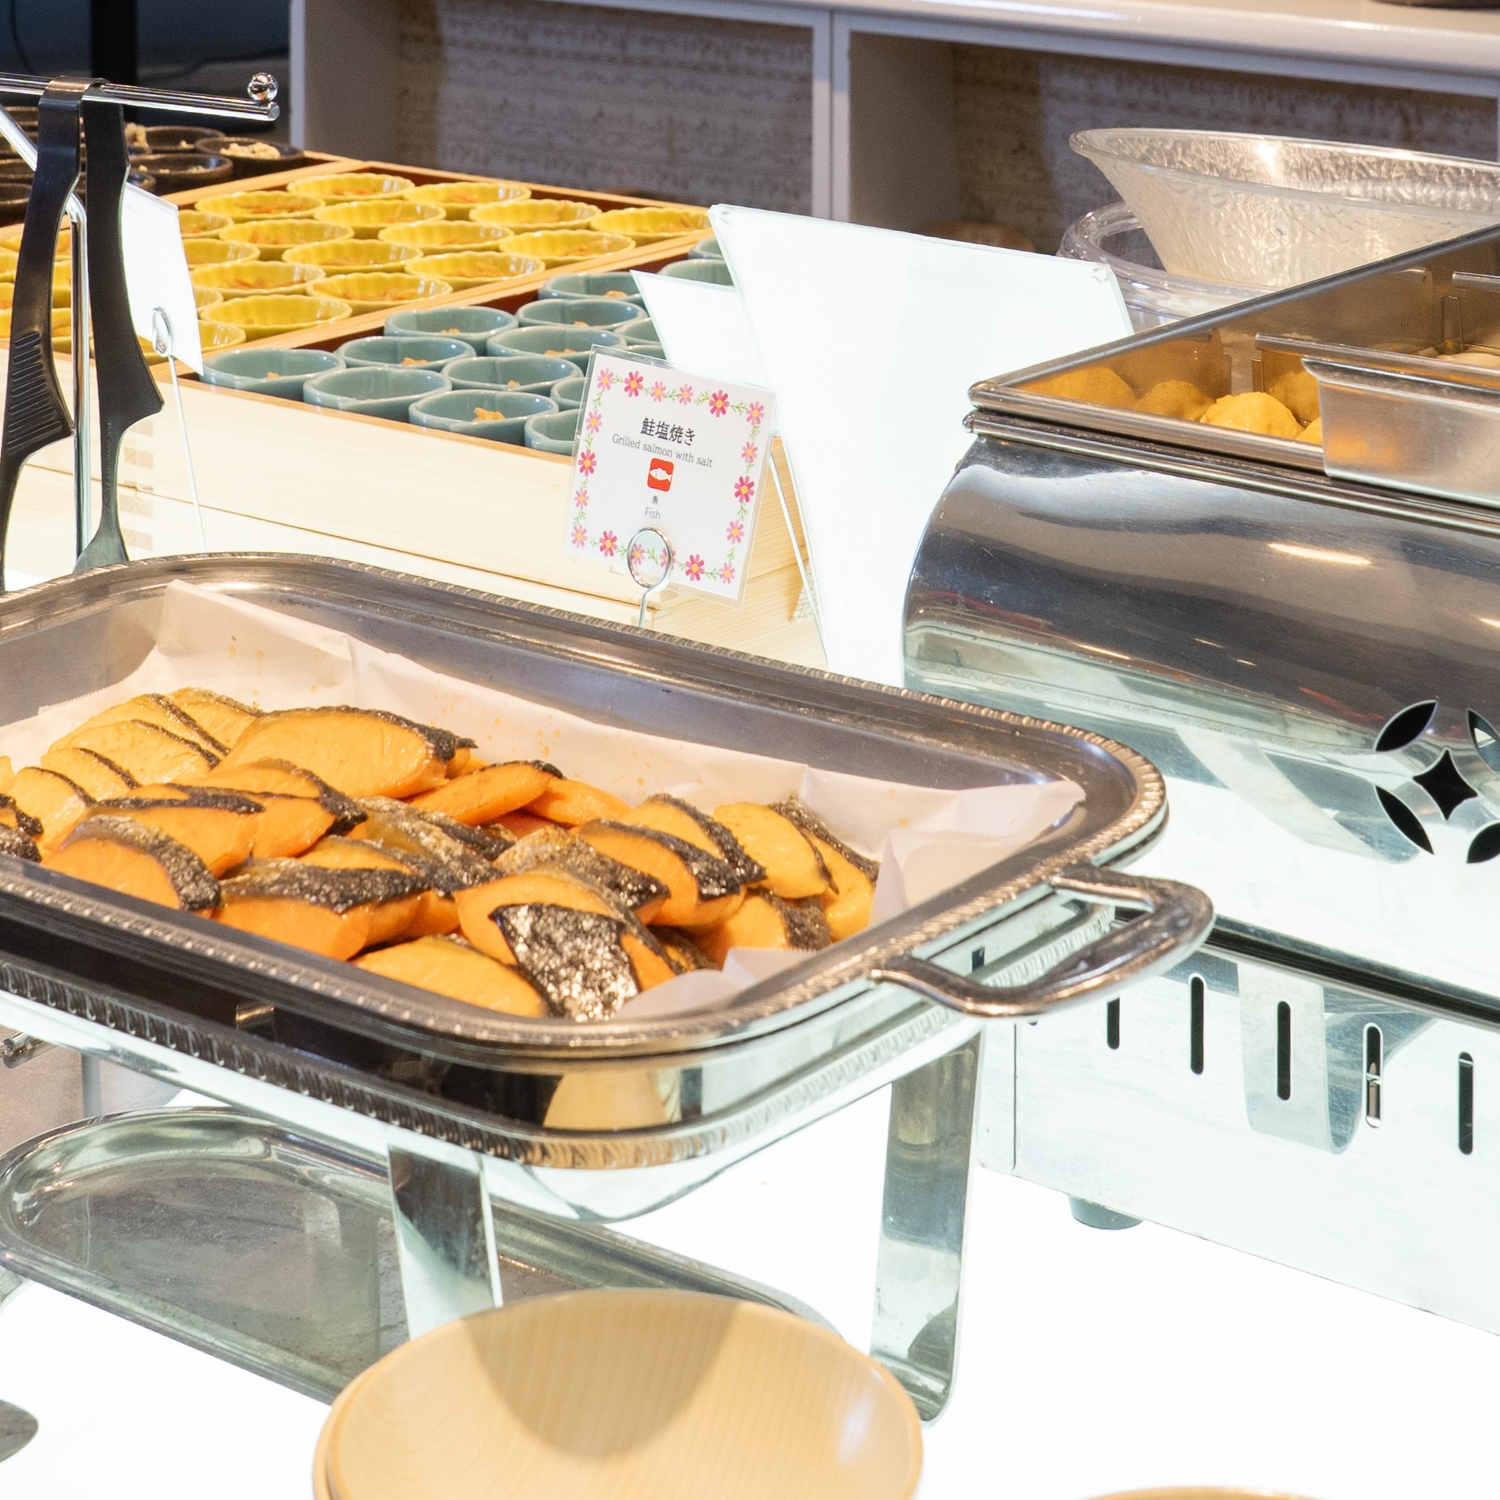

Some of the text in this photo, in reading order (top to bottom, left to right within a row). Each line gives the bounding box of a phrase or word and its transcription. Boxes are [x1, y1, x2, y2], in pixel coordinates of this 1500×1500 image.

[641, 417, 696, 446] 鮭塩焼き
[611, 432, 713, 469] Grilled salmon with salt
[651, 495, 660, 505] 魚
[644, 506, 662, 521] Fish
